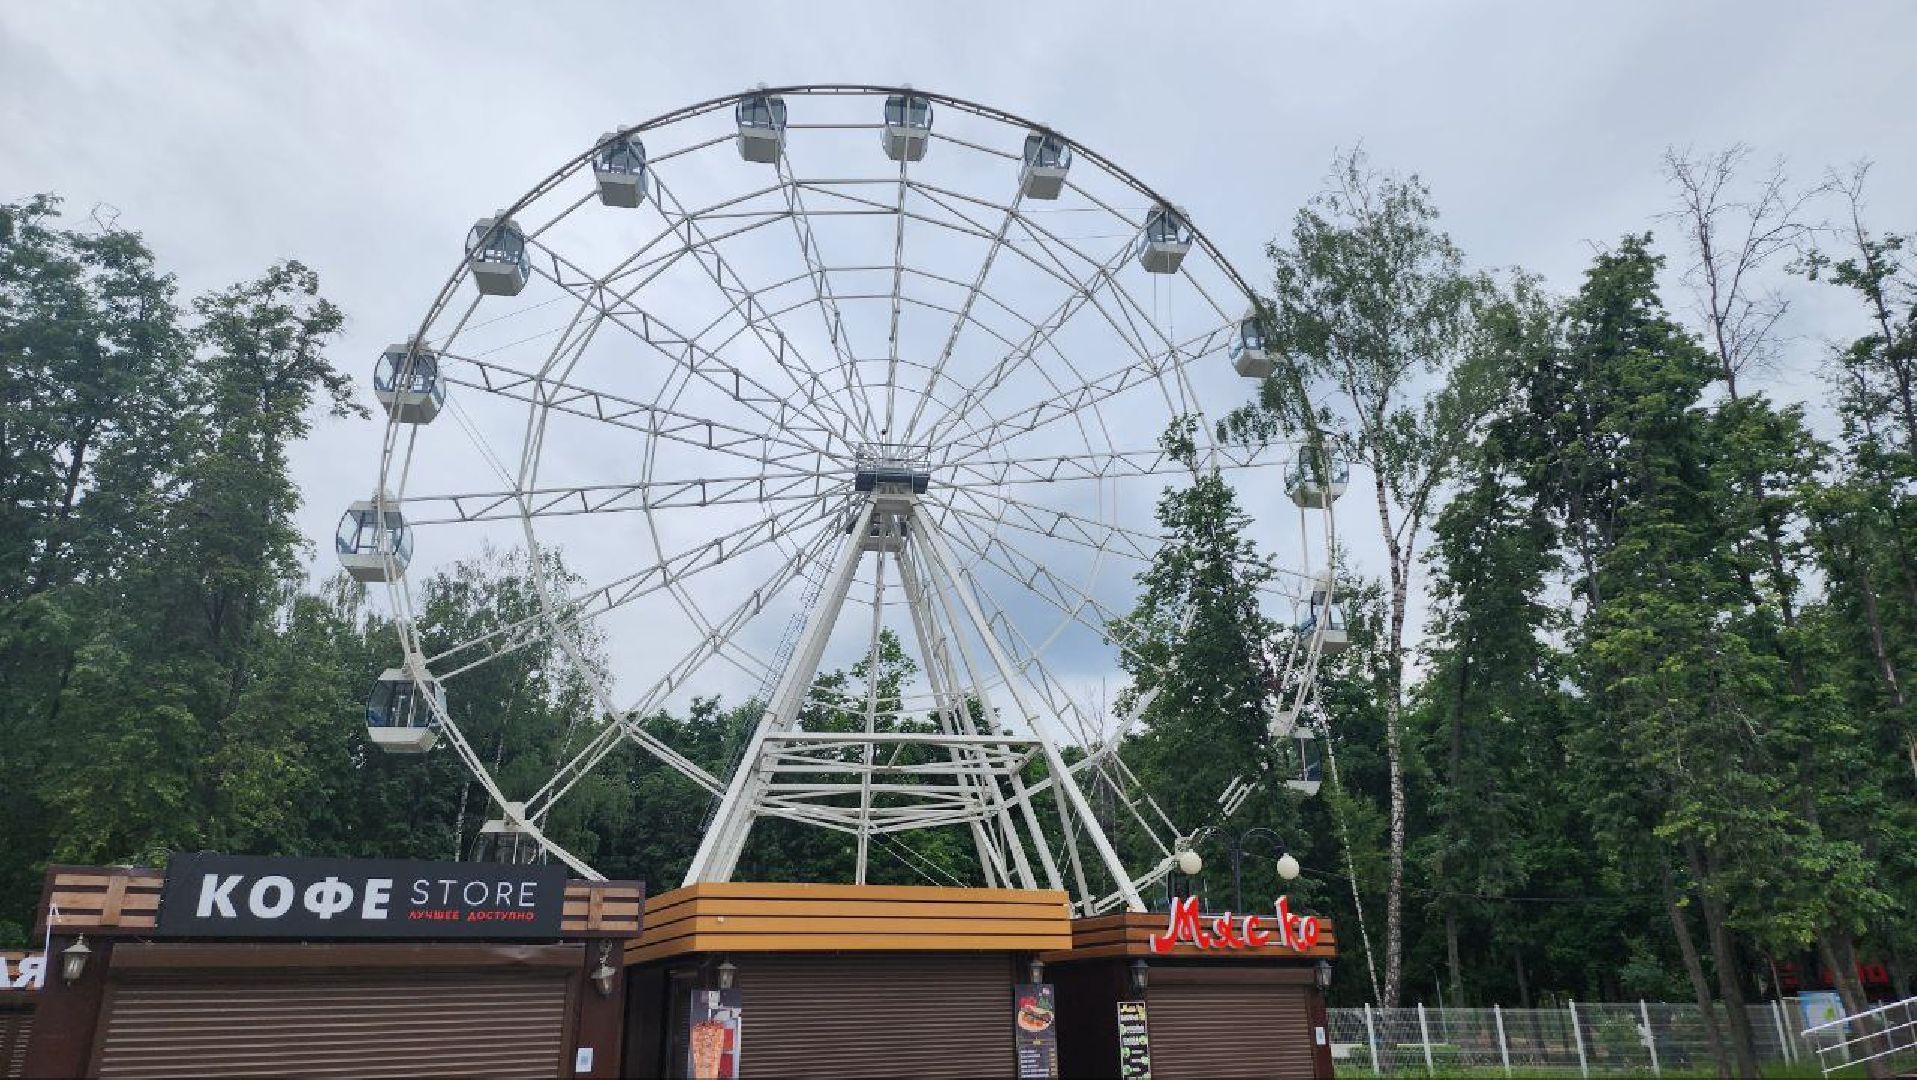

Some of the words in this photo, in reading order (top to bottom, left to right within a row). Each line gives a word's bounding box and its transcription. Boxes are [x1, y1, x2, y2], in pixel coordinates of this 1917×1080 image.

[196, 873, 393, 919] КОФЕ
[410, 879, 538, 907] STORE
[408, 911, 460, 920] ЛУЧШЕЕ
[467, 911, 535, 921] ДОСТУПНО
